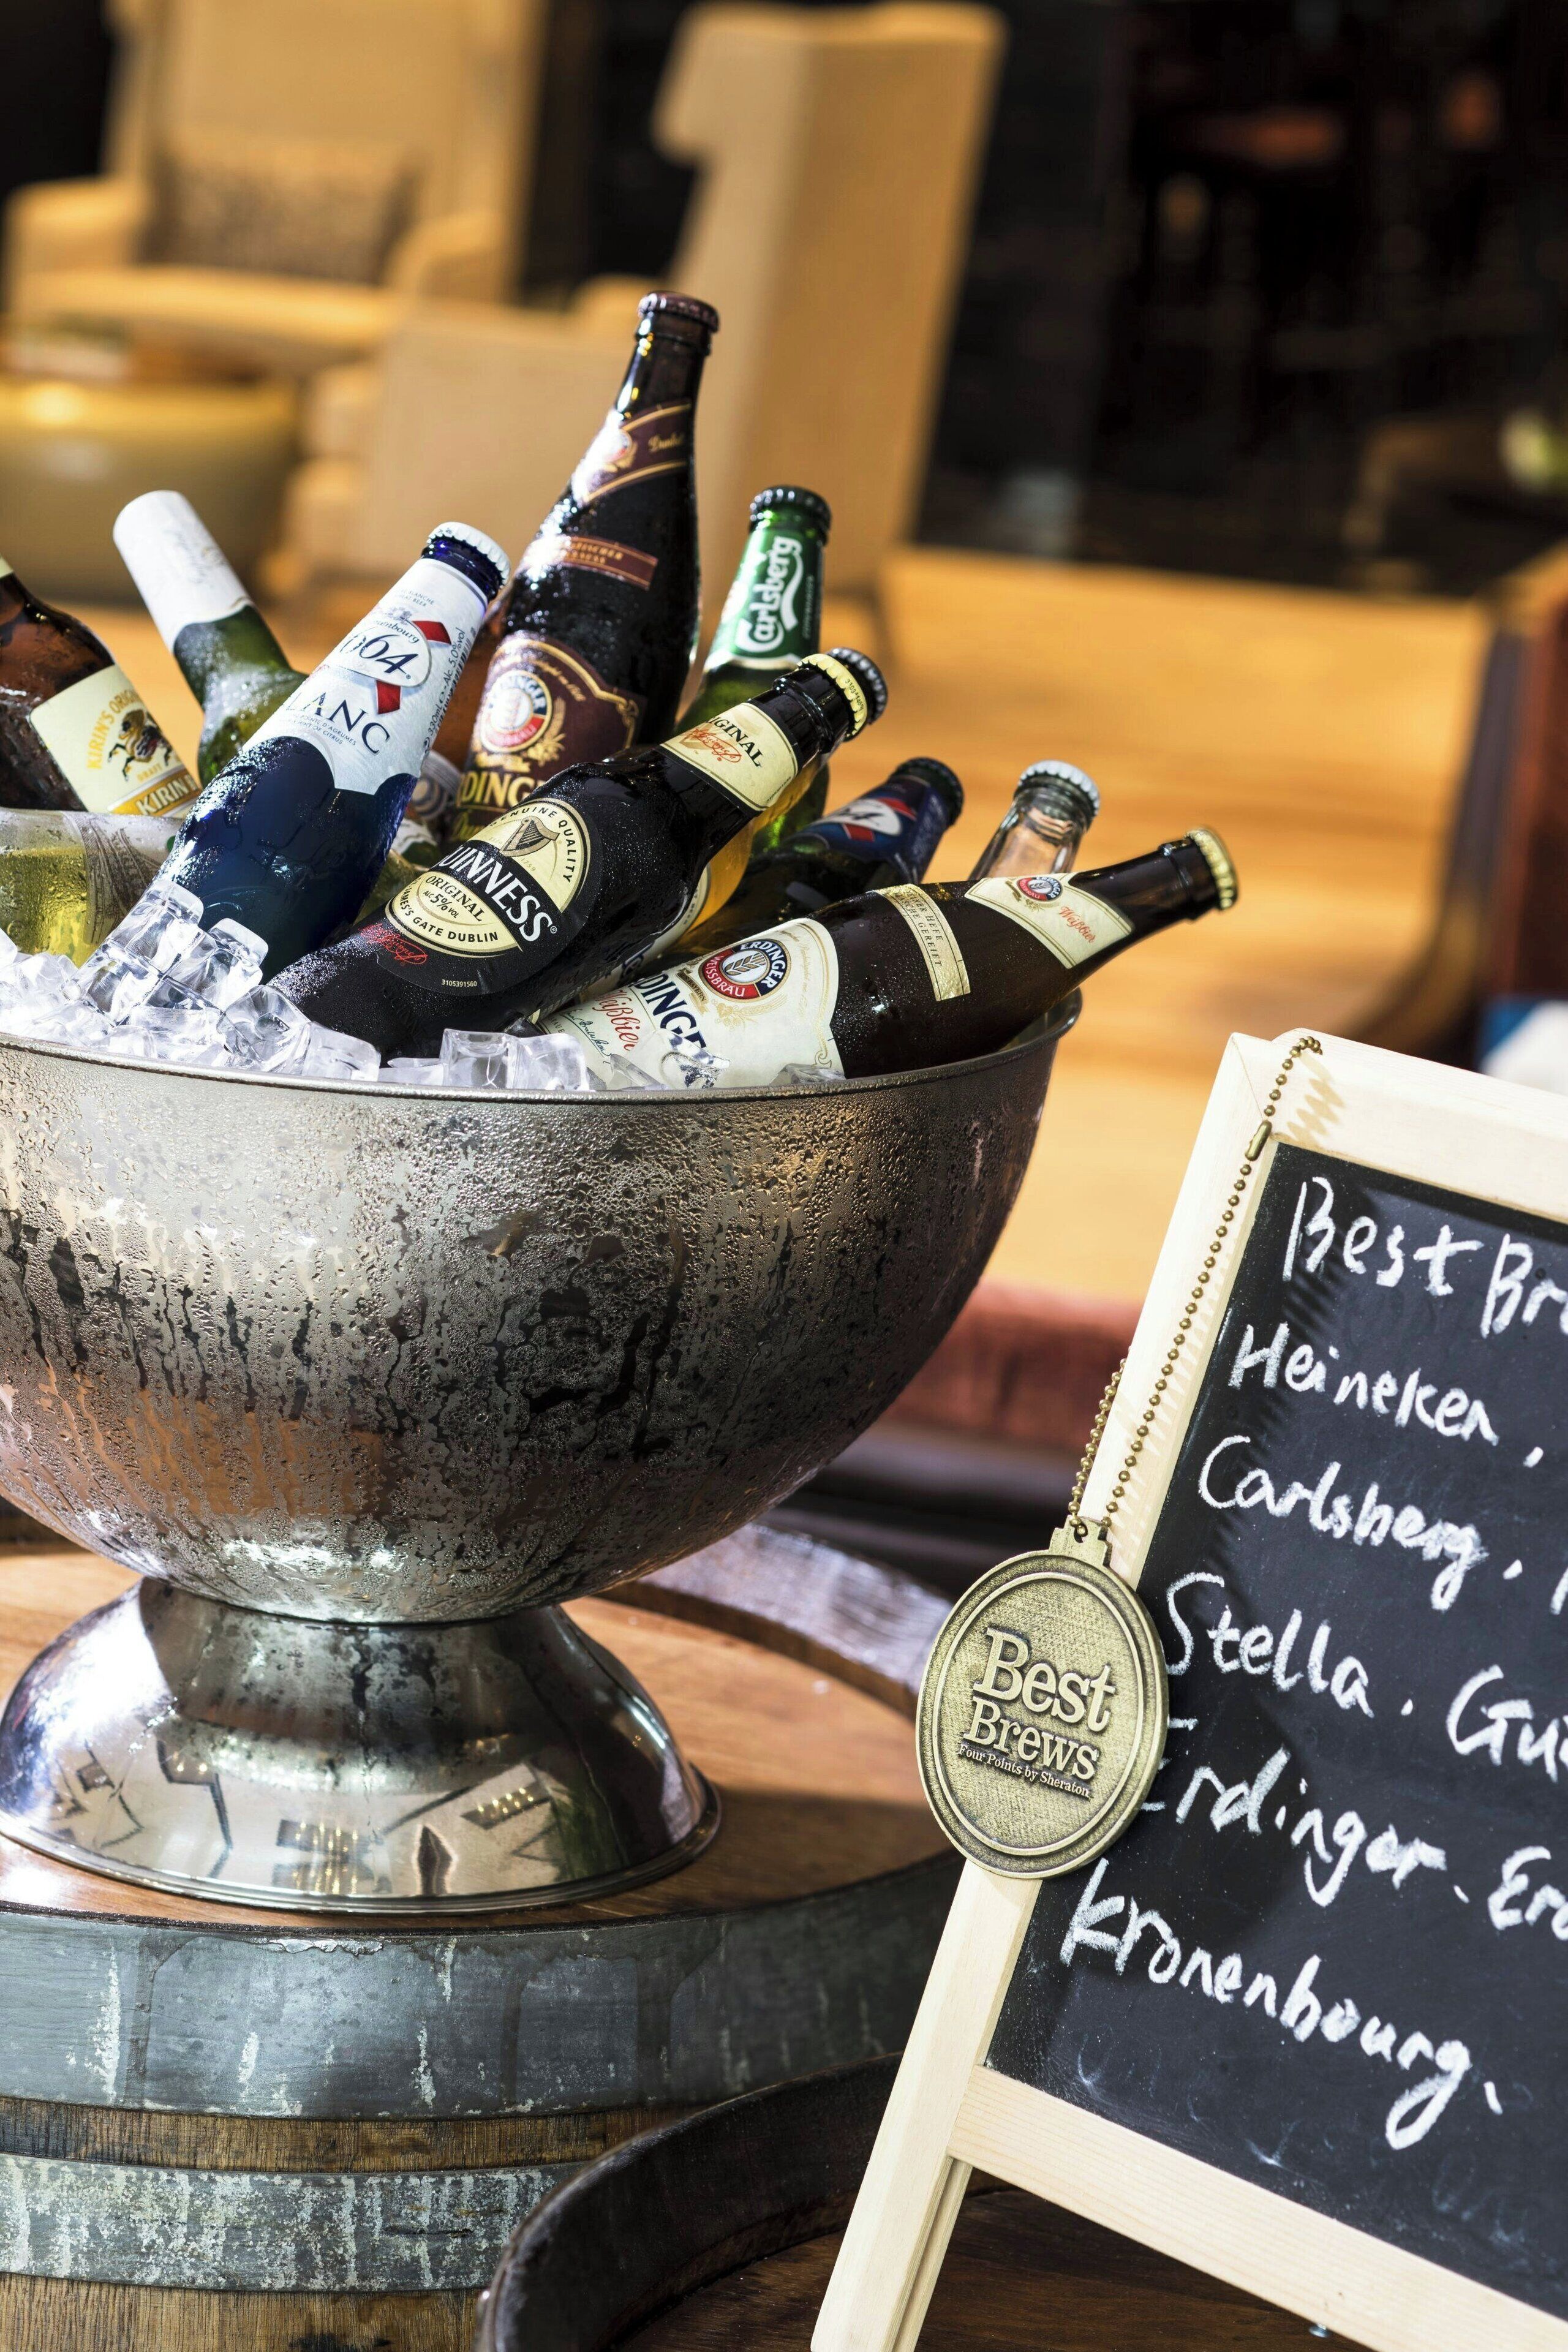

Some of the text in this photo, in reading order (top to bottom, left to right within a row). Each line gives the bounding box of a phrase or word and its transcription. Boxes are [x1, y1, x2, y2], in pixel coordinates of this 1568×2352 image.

[734, 535, 804, 653] Carlsberg
[86, 710, 116, 770] KIRIN'S
[322, 729, 344, 745] CITRUS
[708, 716, 763, 767] IGINAL
[558, 819, 577, 883] QUALITY
[423, 890, 460, 919] ALC 5% VOL
[425, 875, 486, 922] ORIGINAL
[1036, 876, 1061, 899] ERDINGER
[412, 916, 444, 937] GATE
[447, 930, 499, 943] DUBLIN
[918, 922, 943, 967] GEREIFT
[925, 916, 944, 941] HEFE
[1058, 905, 1096, 944] Weißbier
[704, 955, 746, 998] WEISSBRÄU
[739, 940, 787, 989] ERDINGER
[1283, 1176, 1484, 1297] Best
[973, 1627, 1116, 1732] Best
[962, 1695, 1099, 1781] Brews
[958, 1743, 1090, 1798] Four Points by Sheraton
